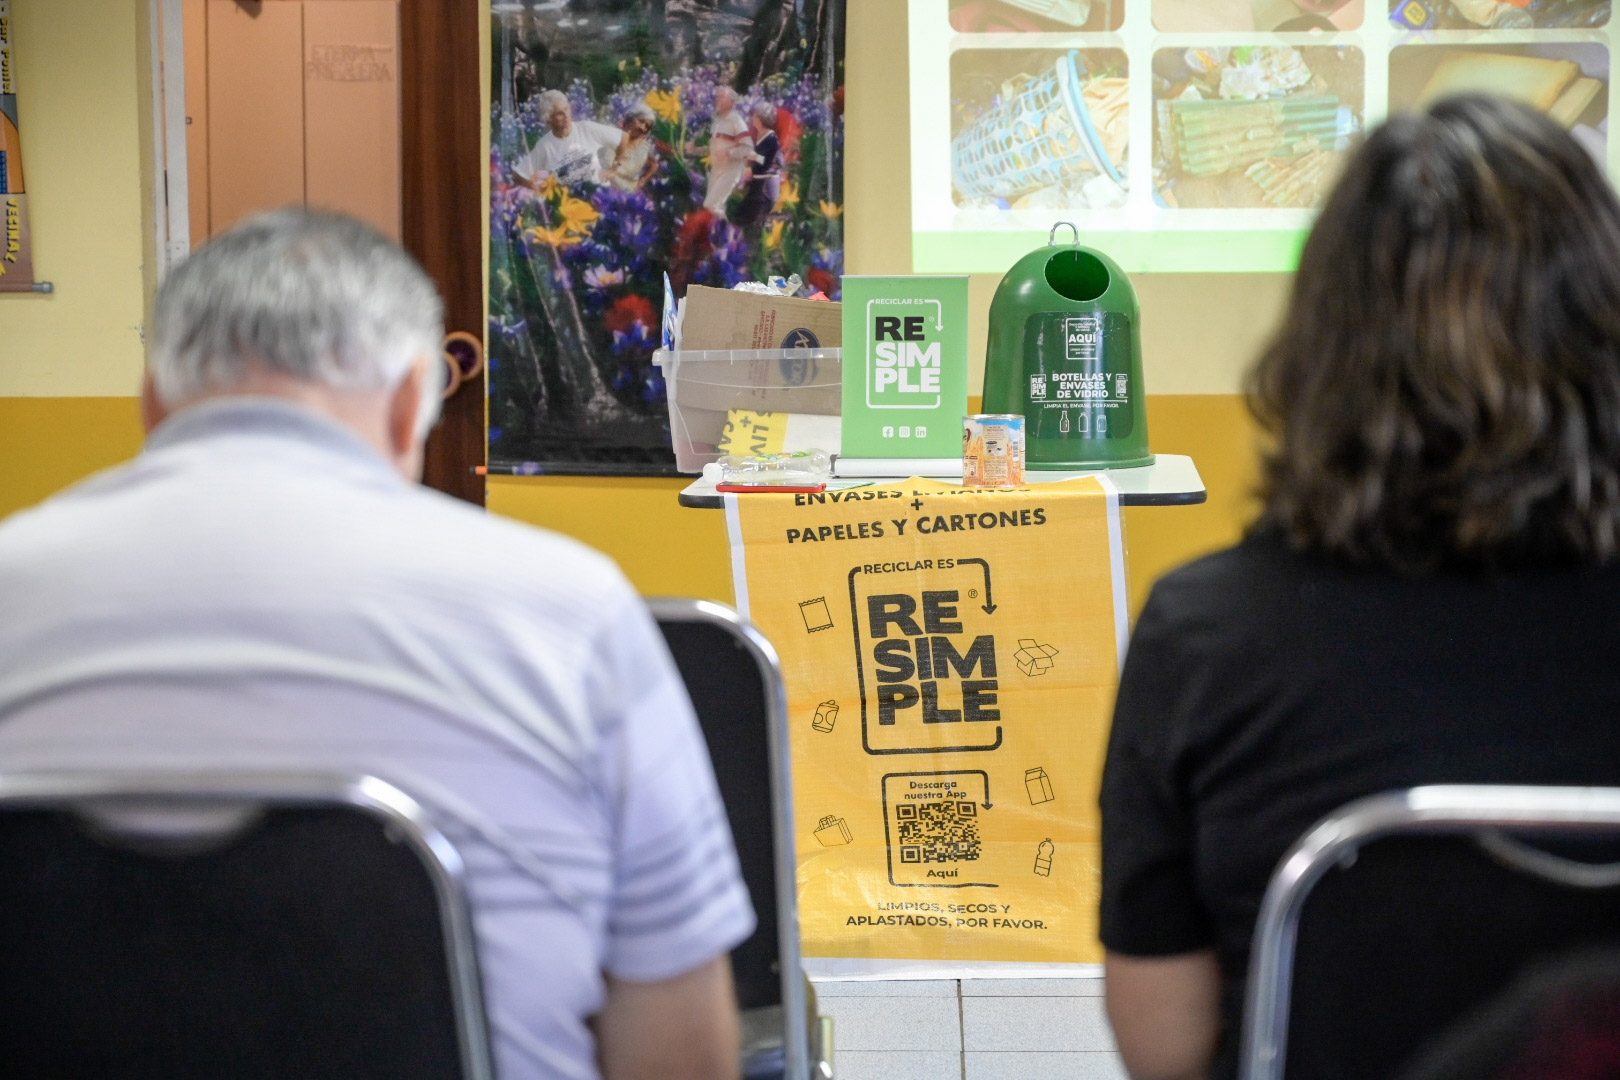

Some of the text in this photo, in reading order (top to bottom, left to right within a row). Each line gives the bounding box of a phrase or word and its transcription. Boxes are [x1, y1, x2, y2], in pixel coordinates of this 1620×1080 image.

[875, 316, 925, 341] RE
[1068, 332, 1097, 343] AQUÍ
[875, 341, 941, 368] SIM
[875, 367, 941, 393] PLE
[1052, 373, 1104, 381] BOTELLAS
[1106, 373, 1112, 381] Y
[1060, 381, 1106, 390] ENVASES
[1056, 390, 1109, 398] DE VIDRIO
[786, 507, 1047, 543] PAPELES Y CARTONES
[863, 558, 955, 574] RECICLAR ES
[867, 590, 963, 638] RE
[873, 635, 998, 683] SIM
[877, 680, 1001, 726] PLE
[909, 781, 957, 790] Descarga
[904, 790, 967, 800] nuestra App
[926, 868, 958, 879] Aquí
[877, 902, 1011, 914] LIMPIOS, SECOS Y
[846, 914, 1048, 930] APLASTADOS, POR FAVOR.
